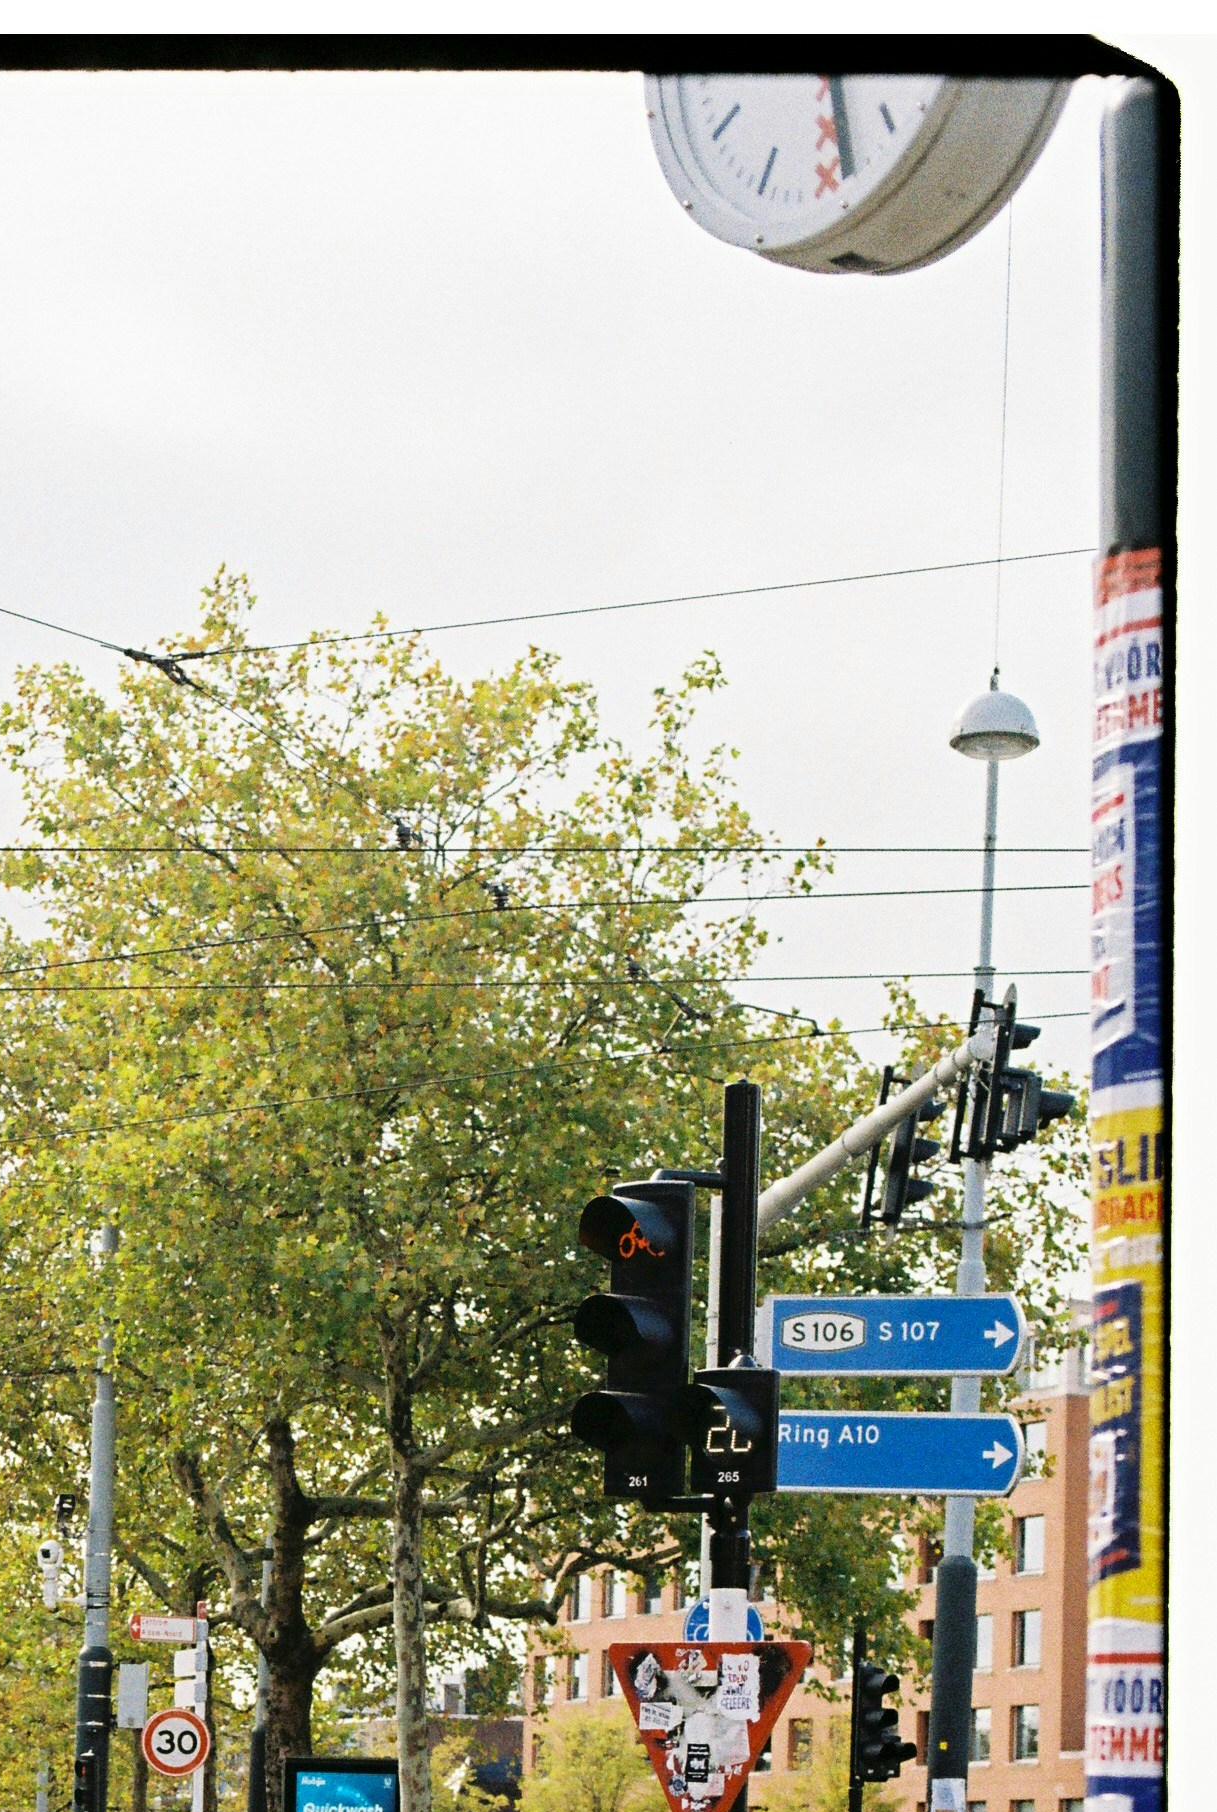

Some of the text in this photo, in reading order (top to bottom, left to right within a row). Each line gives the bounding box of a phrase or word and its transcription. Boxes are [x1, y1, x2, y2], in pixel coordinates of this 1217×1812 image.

[792, 1321, 855, 1342] S 106
[878, 1321, 940, 1341] S 107
[778, 1423, 880, 1449] Ring A10
[628, 1475, 648, 1487] 261
[717, 1471, 740, 1483] 265
[156, 1729, 198, 1755] 30
